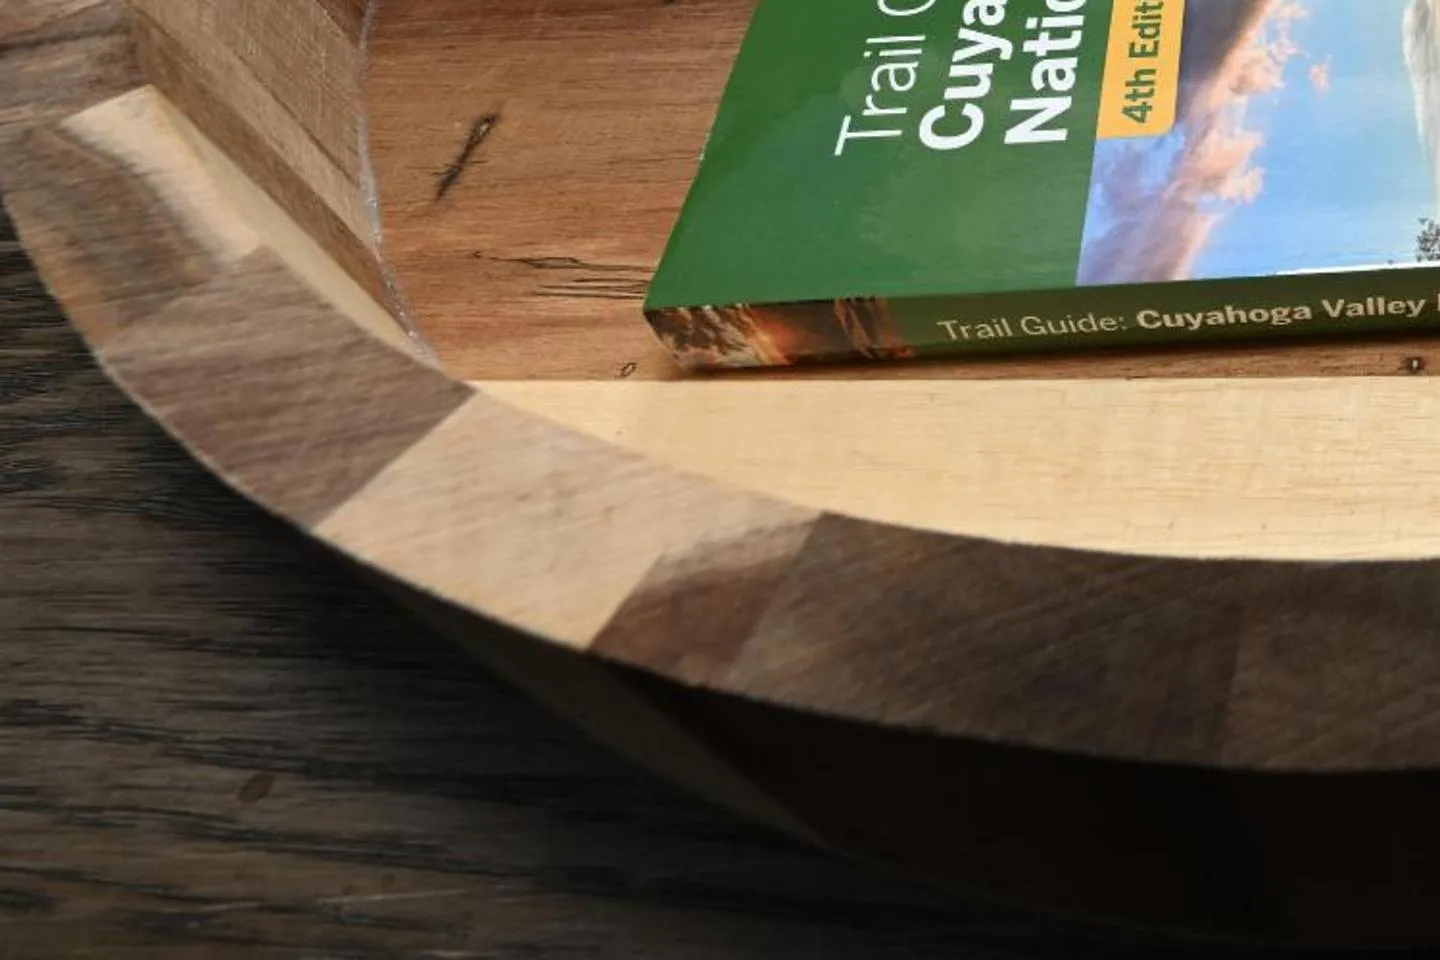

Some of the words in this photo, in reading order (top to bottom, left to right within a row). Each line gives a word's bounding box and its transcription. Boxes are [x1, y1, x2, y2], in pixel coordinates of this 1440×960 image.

[834, 34, 926, 156] Trail
[1122, 68, 1156, 124] 4th
[937, 318, 1013, 340] Trail
[1020, 313, 1127, 337] Guide:
[1136, 304, 1312, 331] Cuyahoga
[1321, 294, 1426, 320] Valley
